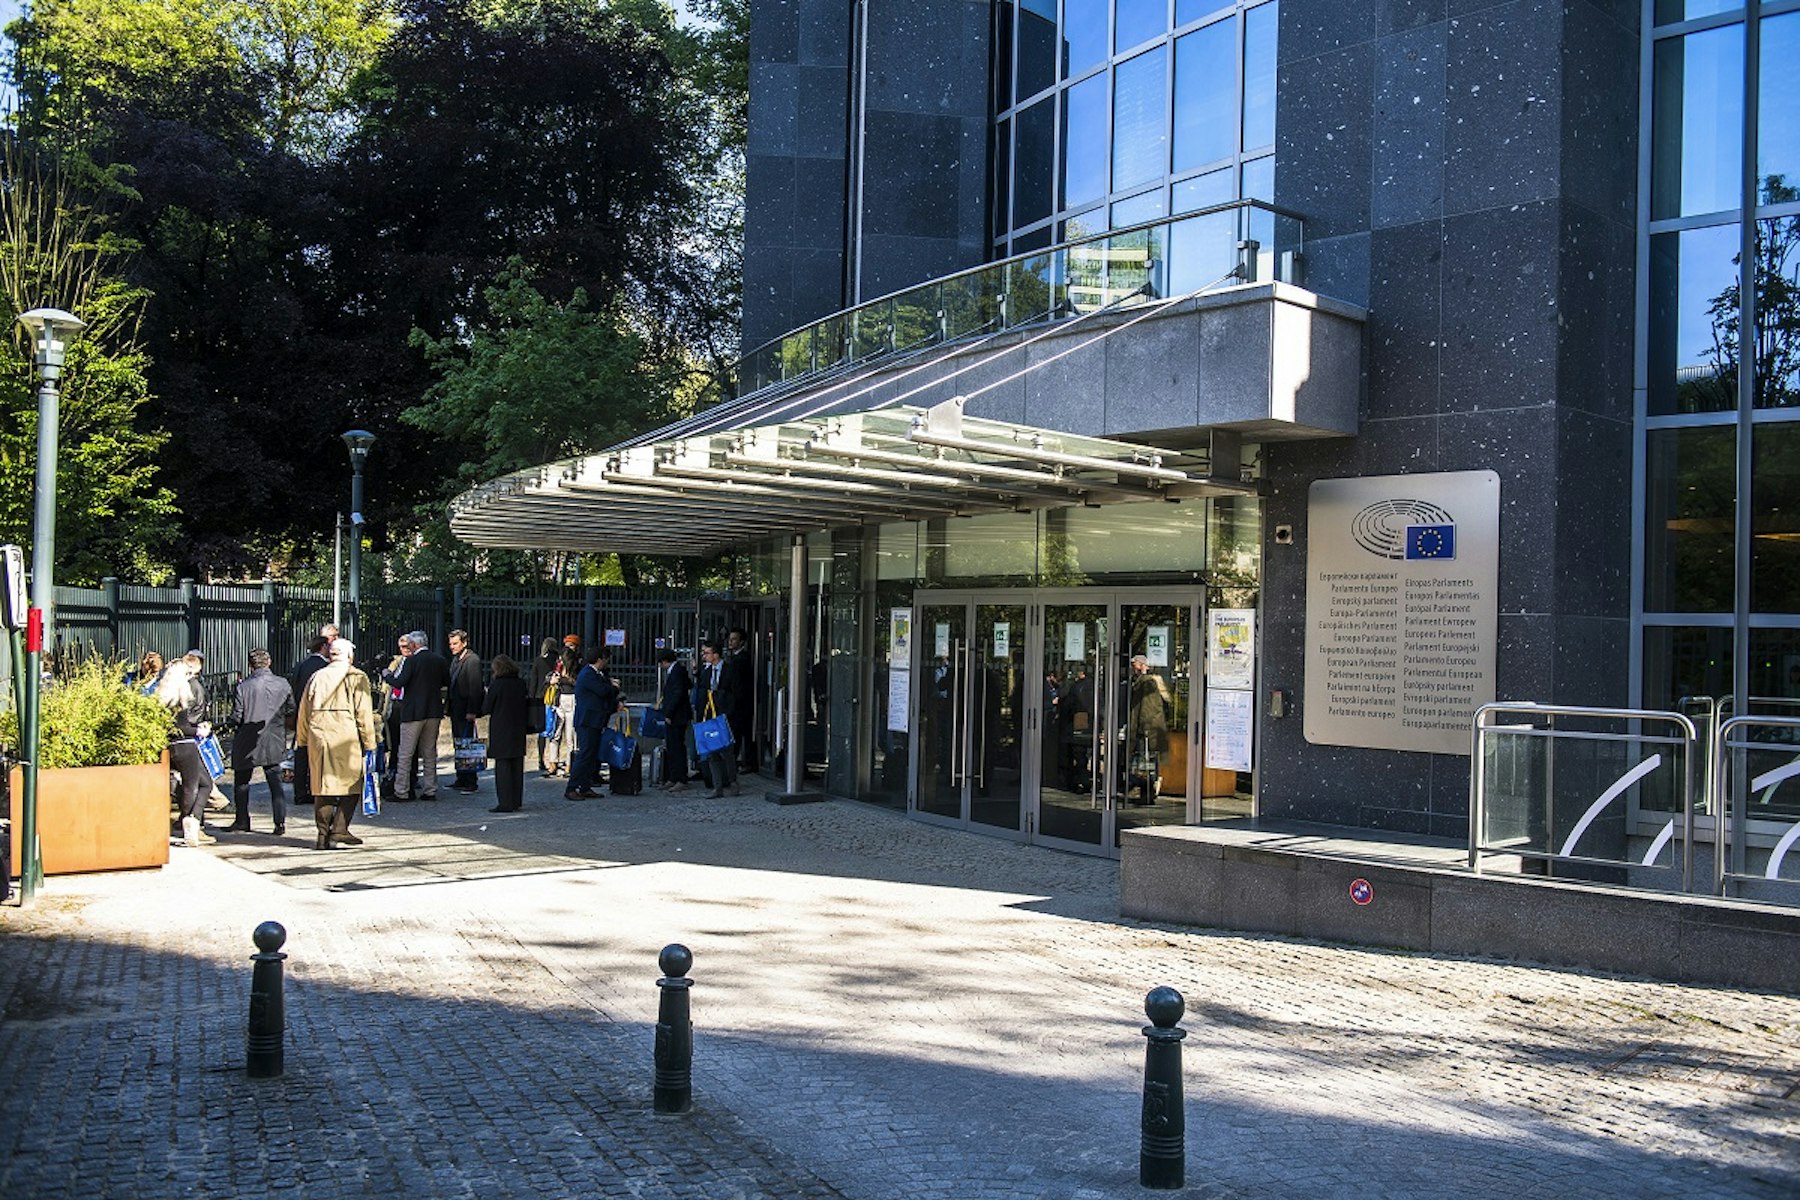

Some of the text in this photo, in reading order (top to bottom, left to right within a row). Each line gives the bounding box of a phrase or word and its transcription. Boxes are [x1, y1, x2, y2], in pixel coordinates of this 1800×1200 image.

[1405, 578, 1473, 588] Eiropas Parlaments
[1332, 584, 1398, 593] Parlamento Europeo
[1363, 597, 1397, 605] parlament
[1405, 591, 1480, 601] Europos Parlamentas
[1433, 604, 1471, 612] Parlament
[1362, 622, 1397, 630] Parlament
[1405, 617, 1476, 627] Parlament Ewropew
[1362, 634, 1397, 642] Parlament
[1405, 630, 1475, 640] Europees Parlement
[1404, 642, 1480, 654] Parlament Europejski
[1327, 658, 1396, 668] European Parliament
[1404, 655, 1476, 667] Parlamento Europeu
[1329, 670, 1362, 680] Parlement
[1404, 667, 1482, 679] Parlamentul European
[1437, 682, 1474, 692] parlament
[1360, 697, 1395, 706] parlament
[1403, 693, 1472, 704] Evropski parlament
[1329, 706, 1395, 720] Parlamento europeo
[1403, 706, 1436, 716] Euroopan
